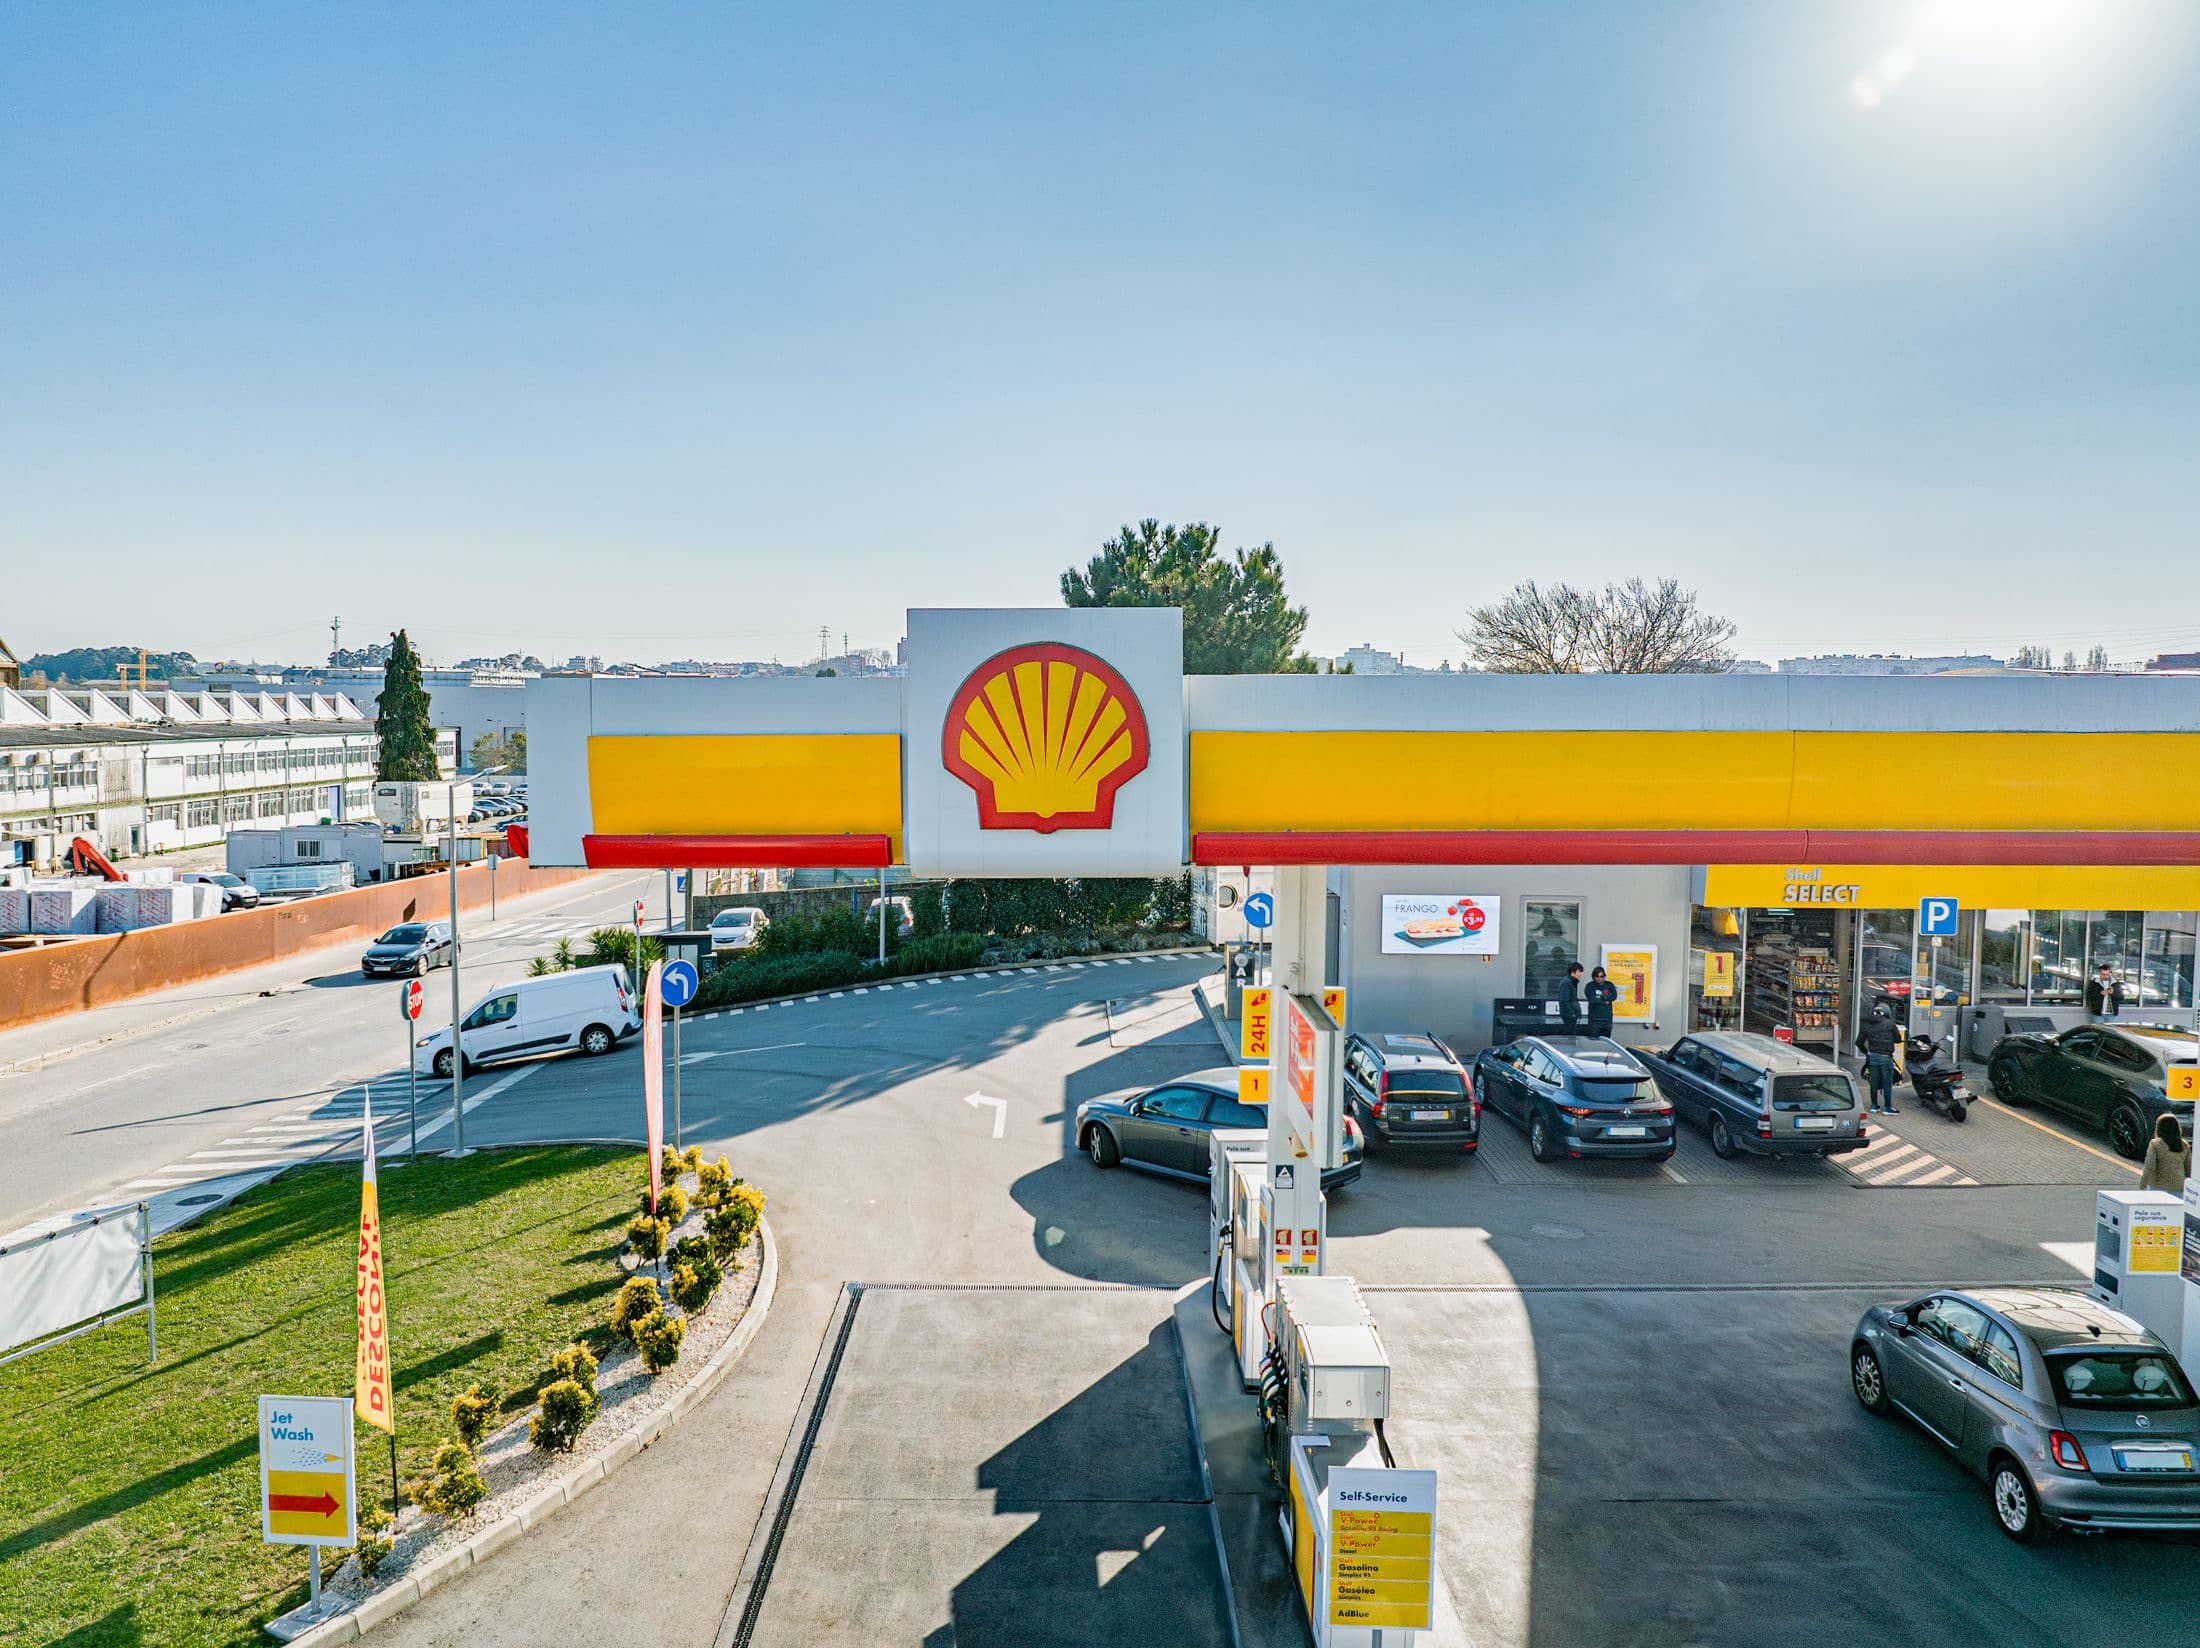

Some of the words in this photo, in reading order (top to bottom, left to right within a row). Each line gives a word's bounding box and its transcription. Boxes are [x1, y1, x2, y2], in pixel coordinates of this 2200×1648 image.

[1786, 868, 1821, 880] Shell
[1784, 885, 1860, 903] SELECT
[1395, 904, 1439, 913] FRANGO
[1928, 901, 1950, 932] P
[408, 991, 422, 1010] STOP
[1251, 1016, 1266, 1053] 24H
[1253, 1079, 1259, 1091] 1
[2183, 1076, 2193, 1089] 3
[270, 1411, 293, 1424] Jet
[271, 1427, 314, 1441] Wash
[1340, 1491, 1408, 1503] Self-Service
[1340, 1517, 1377, 1525] V-Power
[1340, 1540, 1377, 1548] V-Power
[1339, 1563, 1379, 1572] Gasolina
[1339, 1586, 1375, 1594] Gasóleo
[1338, 1609, 1369, 1617] AdBlue
